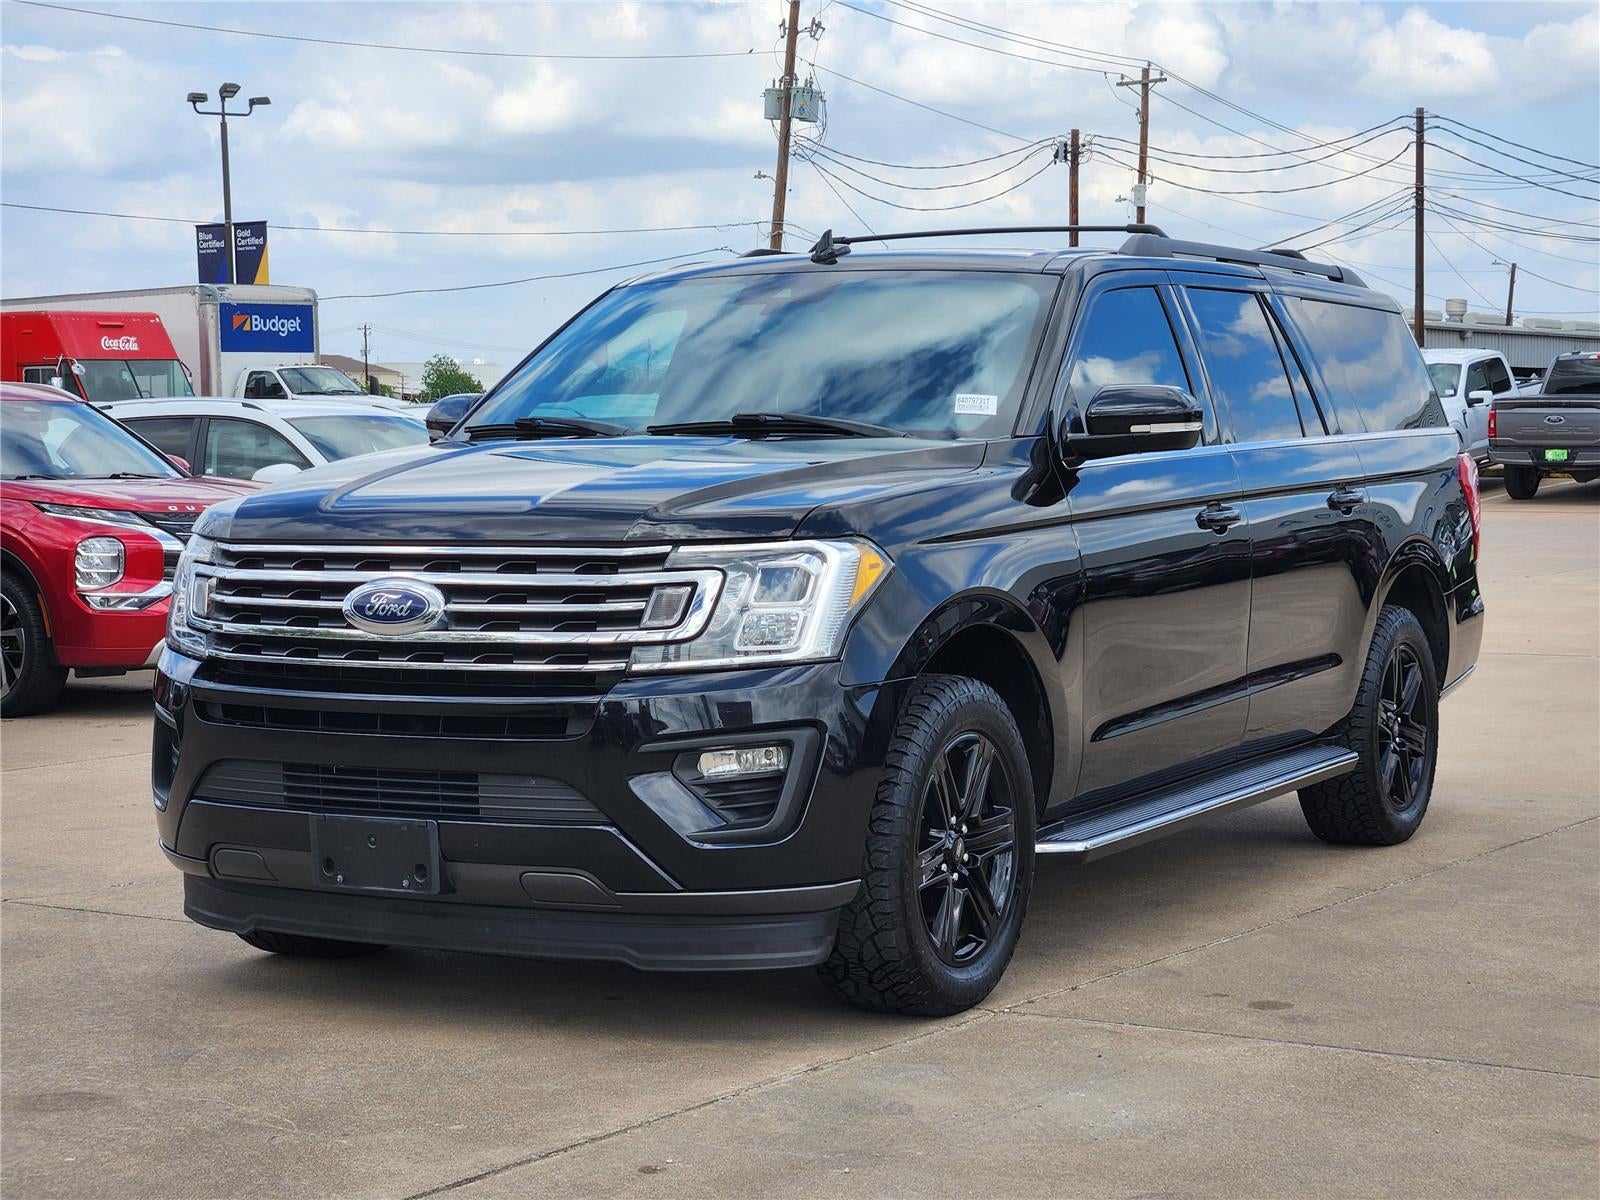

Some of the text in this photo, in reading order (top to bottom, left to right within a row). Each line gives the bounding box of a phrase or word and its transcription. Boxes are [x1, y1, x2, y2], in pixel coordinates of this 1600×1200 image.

[198, 232, 213, 240] Blue
[236, 229, 250, 237] Gold
[198, 240, 225, 248] Certified
[236, 237, 263, 245] Certified
[251, 315, 301, 336] Budget
[364, 592, 413, 617] Ford
